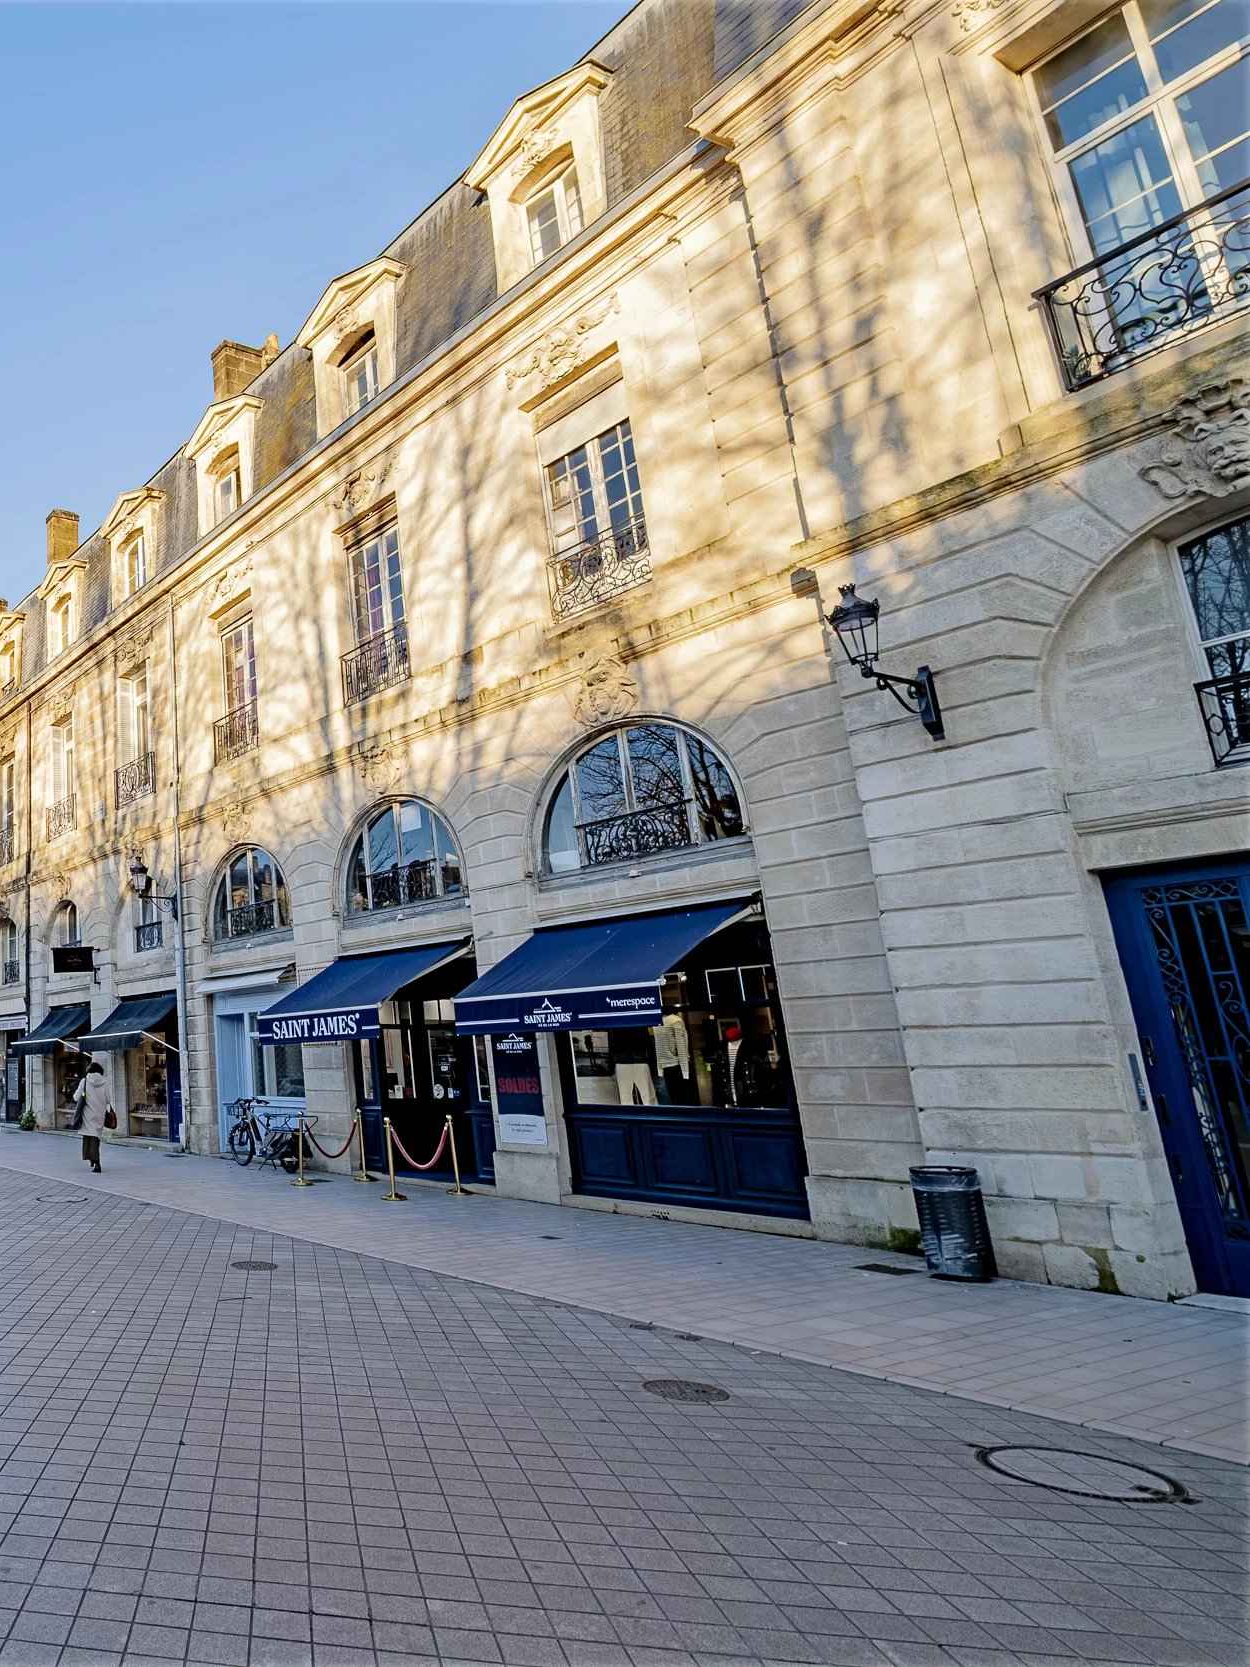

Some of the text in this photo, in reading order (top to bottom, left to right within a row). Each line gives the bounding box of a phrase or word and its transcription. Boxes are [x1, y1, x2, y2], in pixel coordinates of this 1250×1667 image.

[609, 996, 656, 1009] merespace
[524, 1012, 571, 1024] SAINT JAMES
[272, 1014, 357, 1040] SAINT JAMES
[496, 1041, 532, 1050] SAINT JAMES
[498, 1077, 540, 1095] SOLDES
